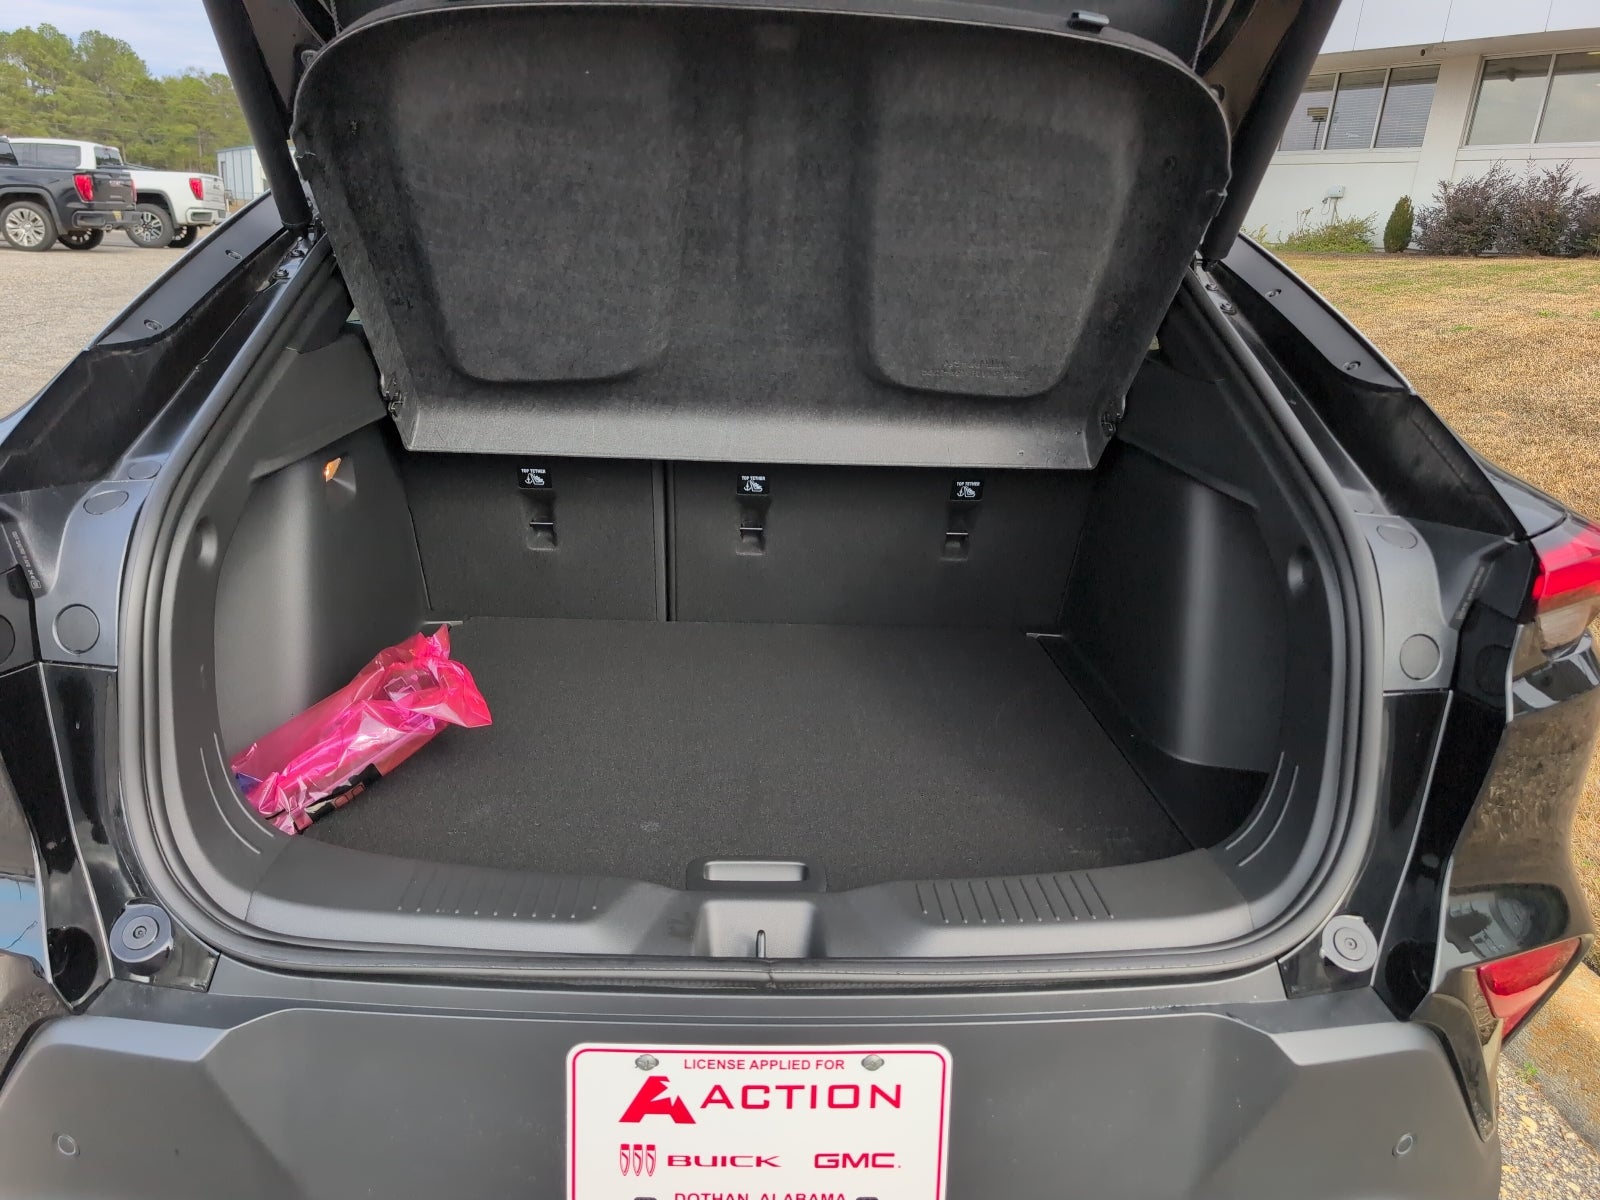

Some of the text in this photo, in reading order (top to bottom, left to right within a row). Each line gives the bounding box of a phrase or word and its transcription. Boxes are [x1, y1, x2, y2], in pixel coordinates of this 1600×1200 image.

[684, 1059, 845, 1070] LICENSE APPLIED FOR
[700, 1084, 902, 1110] ACTION
[667, 1155, 782, 1168] BUICK
